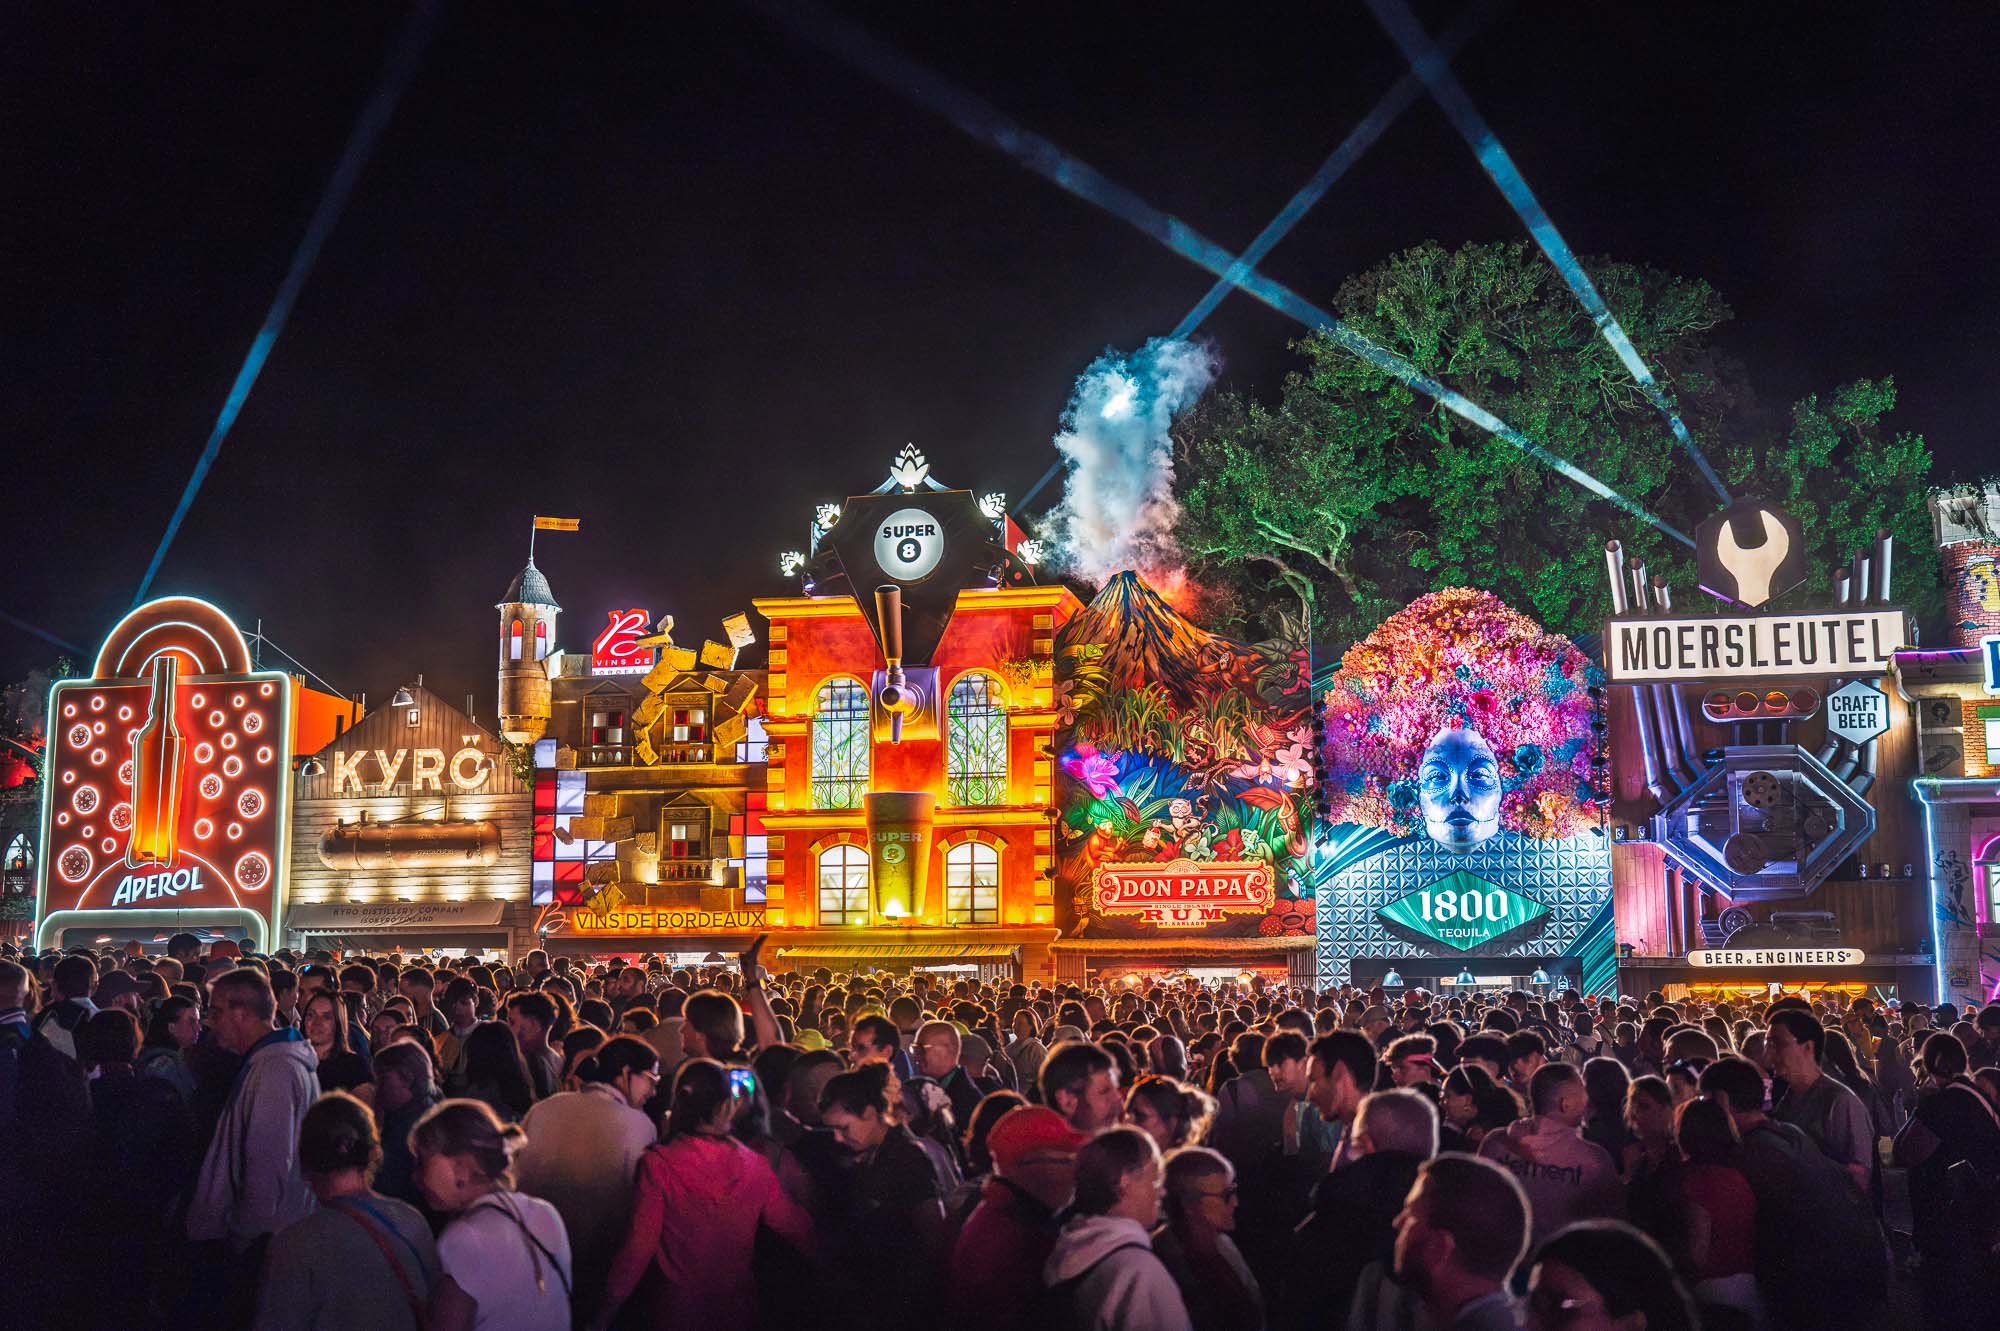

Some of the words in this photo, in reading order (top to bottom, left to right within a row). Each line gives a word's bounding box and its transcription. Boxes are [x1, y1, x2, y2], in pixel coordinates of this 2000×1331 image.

[882, 524, 936, 539] SUPER
[902, 543, 916, 558] 8
[1621, 618, 1890, 672] MOERSLEUTEL
[1831, 695, 1880, 714] CRAFT
[1838, 712, 1878, 729] BEER
[333, 734, 489, 793] KYRÖ
[112, 866, 204, 907] APEROL
[1123, 878, 1172, 897] DON
[1180, 878, 1245, 897] PAPA
[1143, 908, 1223, 921] RUM
[1418, 889, 1508, 922] 1800
[576, 912, 619, 929] VINS
[626, 913, 652, 929] DE
[657, 911, 765, 928] BORDEAUX
[1438, 928, 1491, 938] TEQUILA
[1705, 952, 1743, 964] BEER
[1756, 951, 1846, 963] ENGINEERS
[1497, 1152, 1582, 1184] lement
